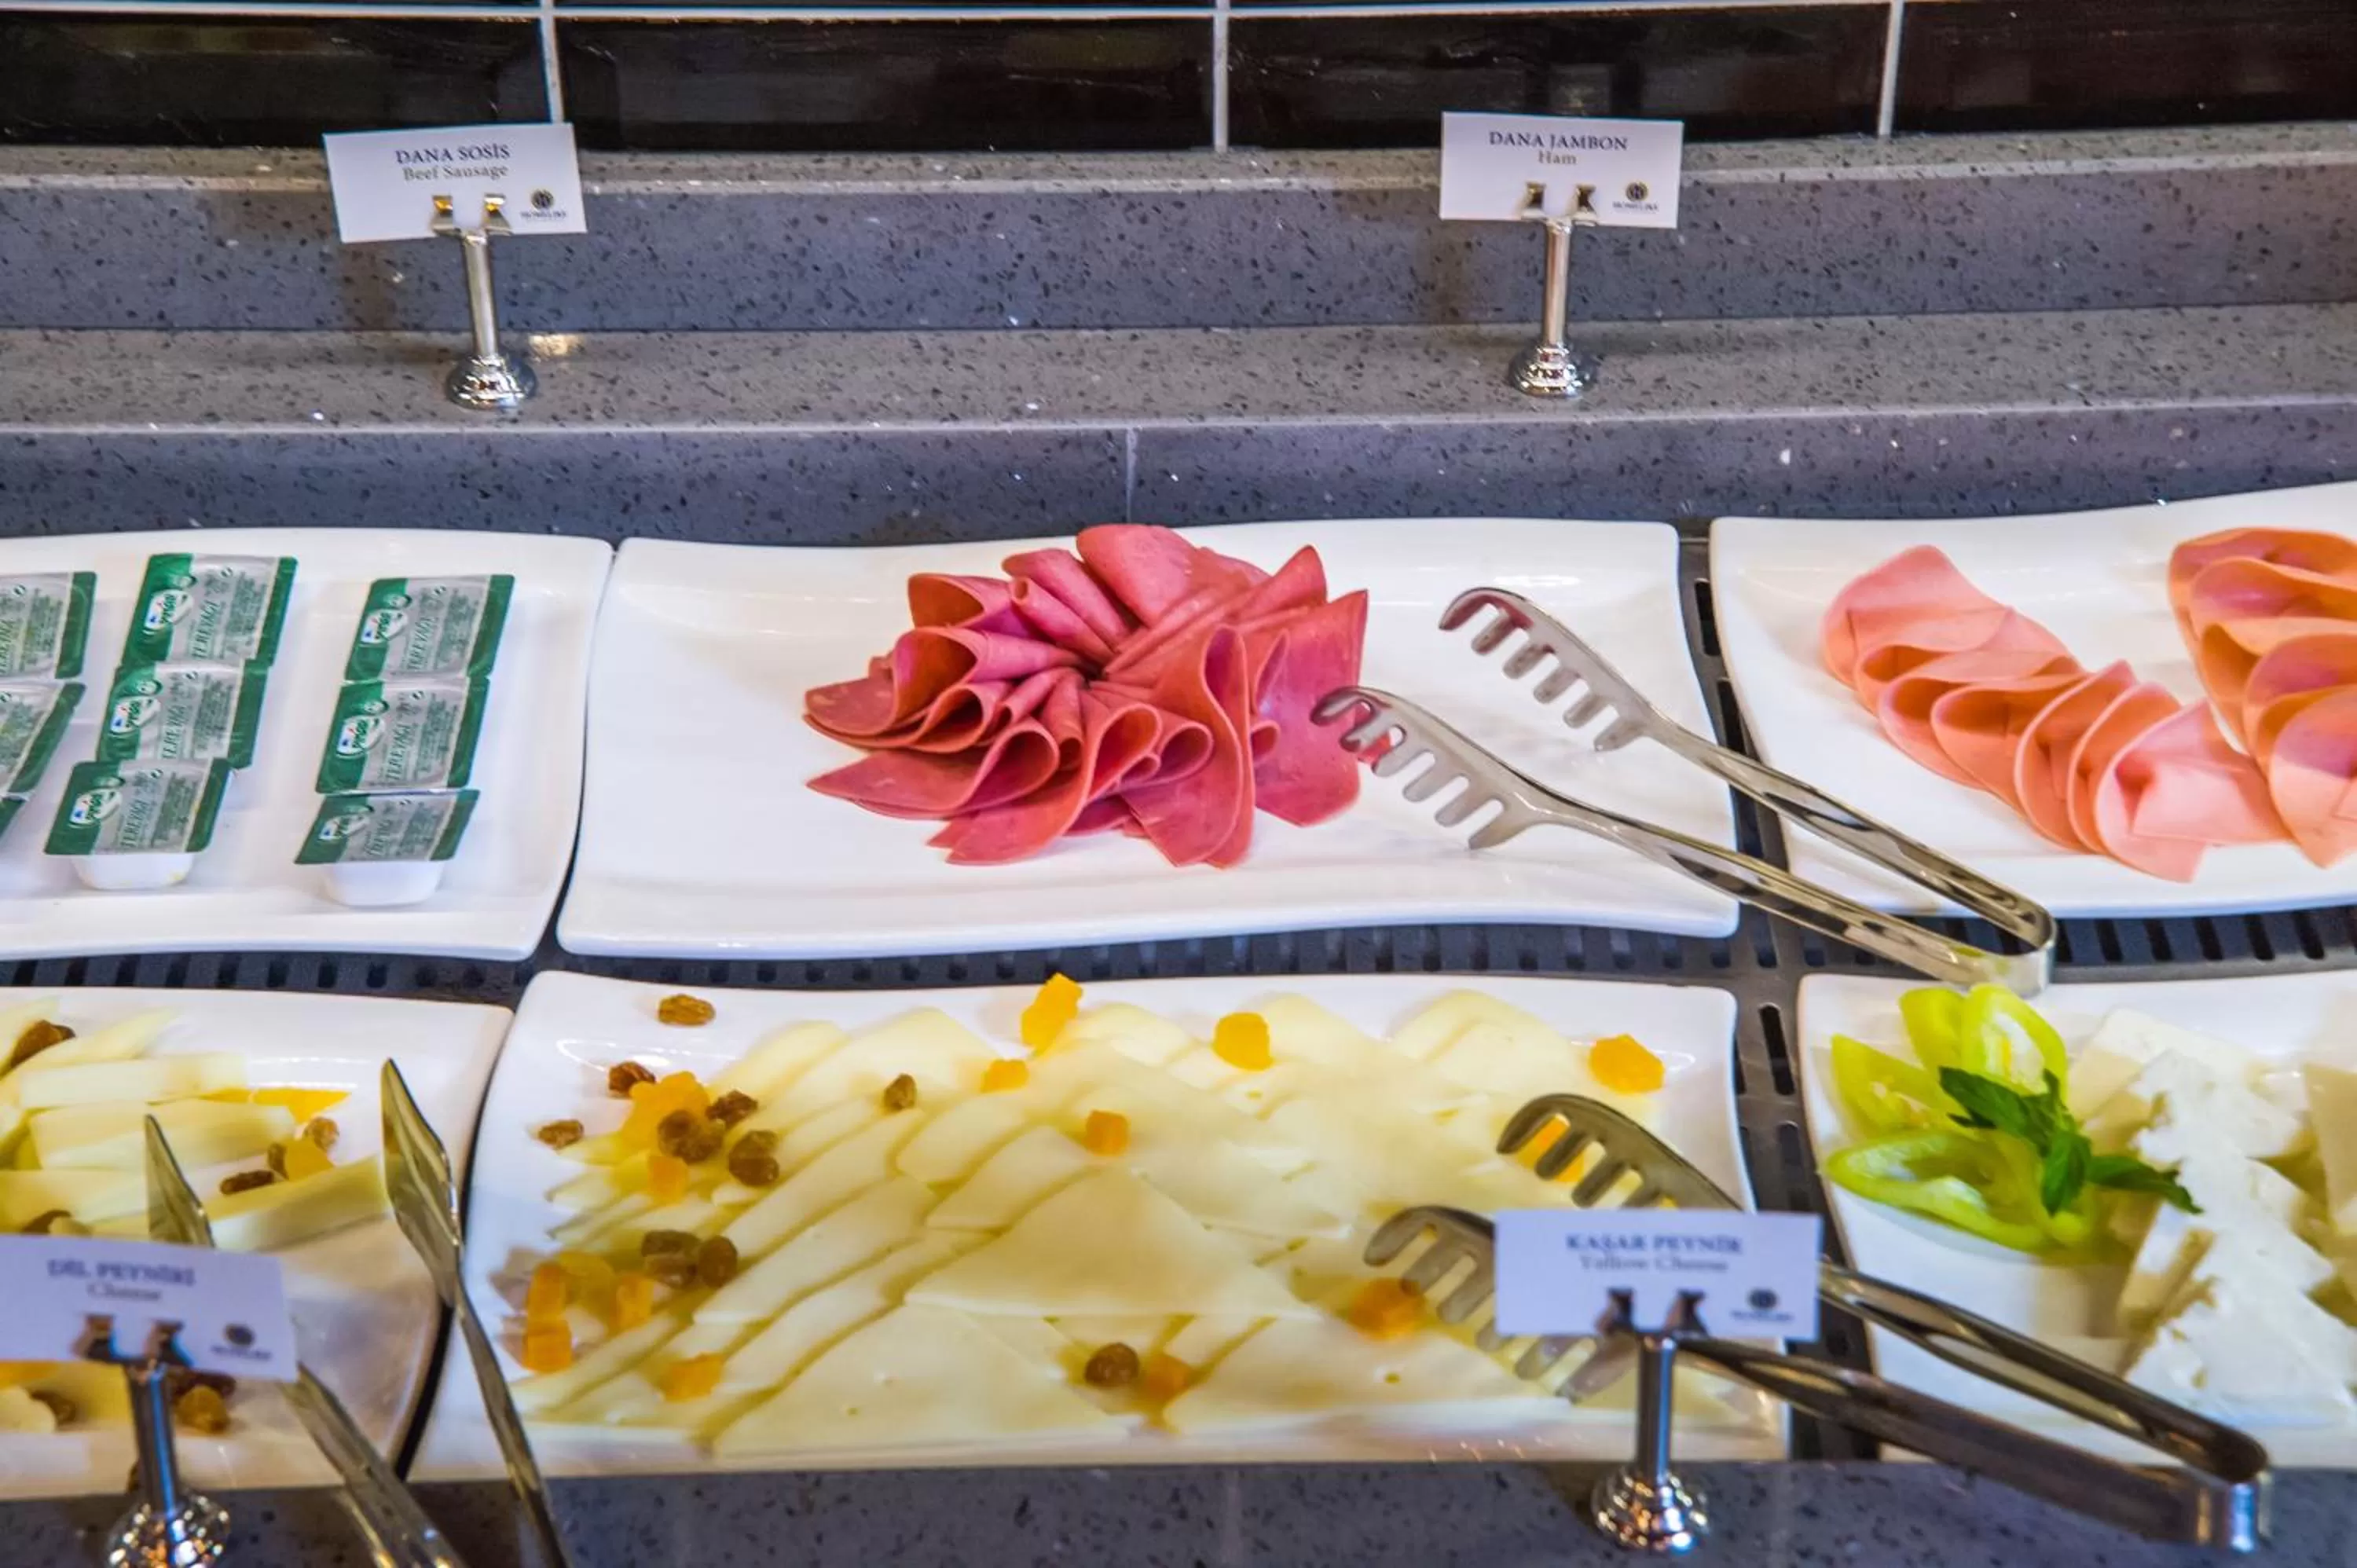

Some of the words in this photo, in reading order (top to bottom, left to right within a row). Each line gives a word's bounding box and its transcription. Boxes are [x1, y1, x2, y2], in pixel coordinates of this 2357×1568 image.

[1489, 130, 1545, 148] DANA
[1549, 133, 1628, 151] JAMBON
[395, 147, 454, 164] DANA
[1538, 150, 1578, 165] Ham
[401, 164, 440, 181] Beef
[442, 166, 509, 181] Sausage
